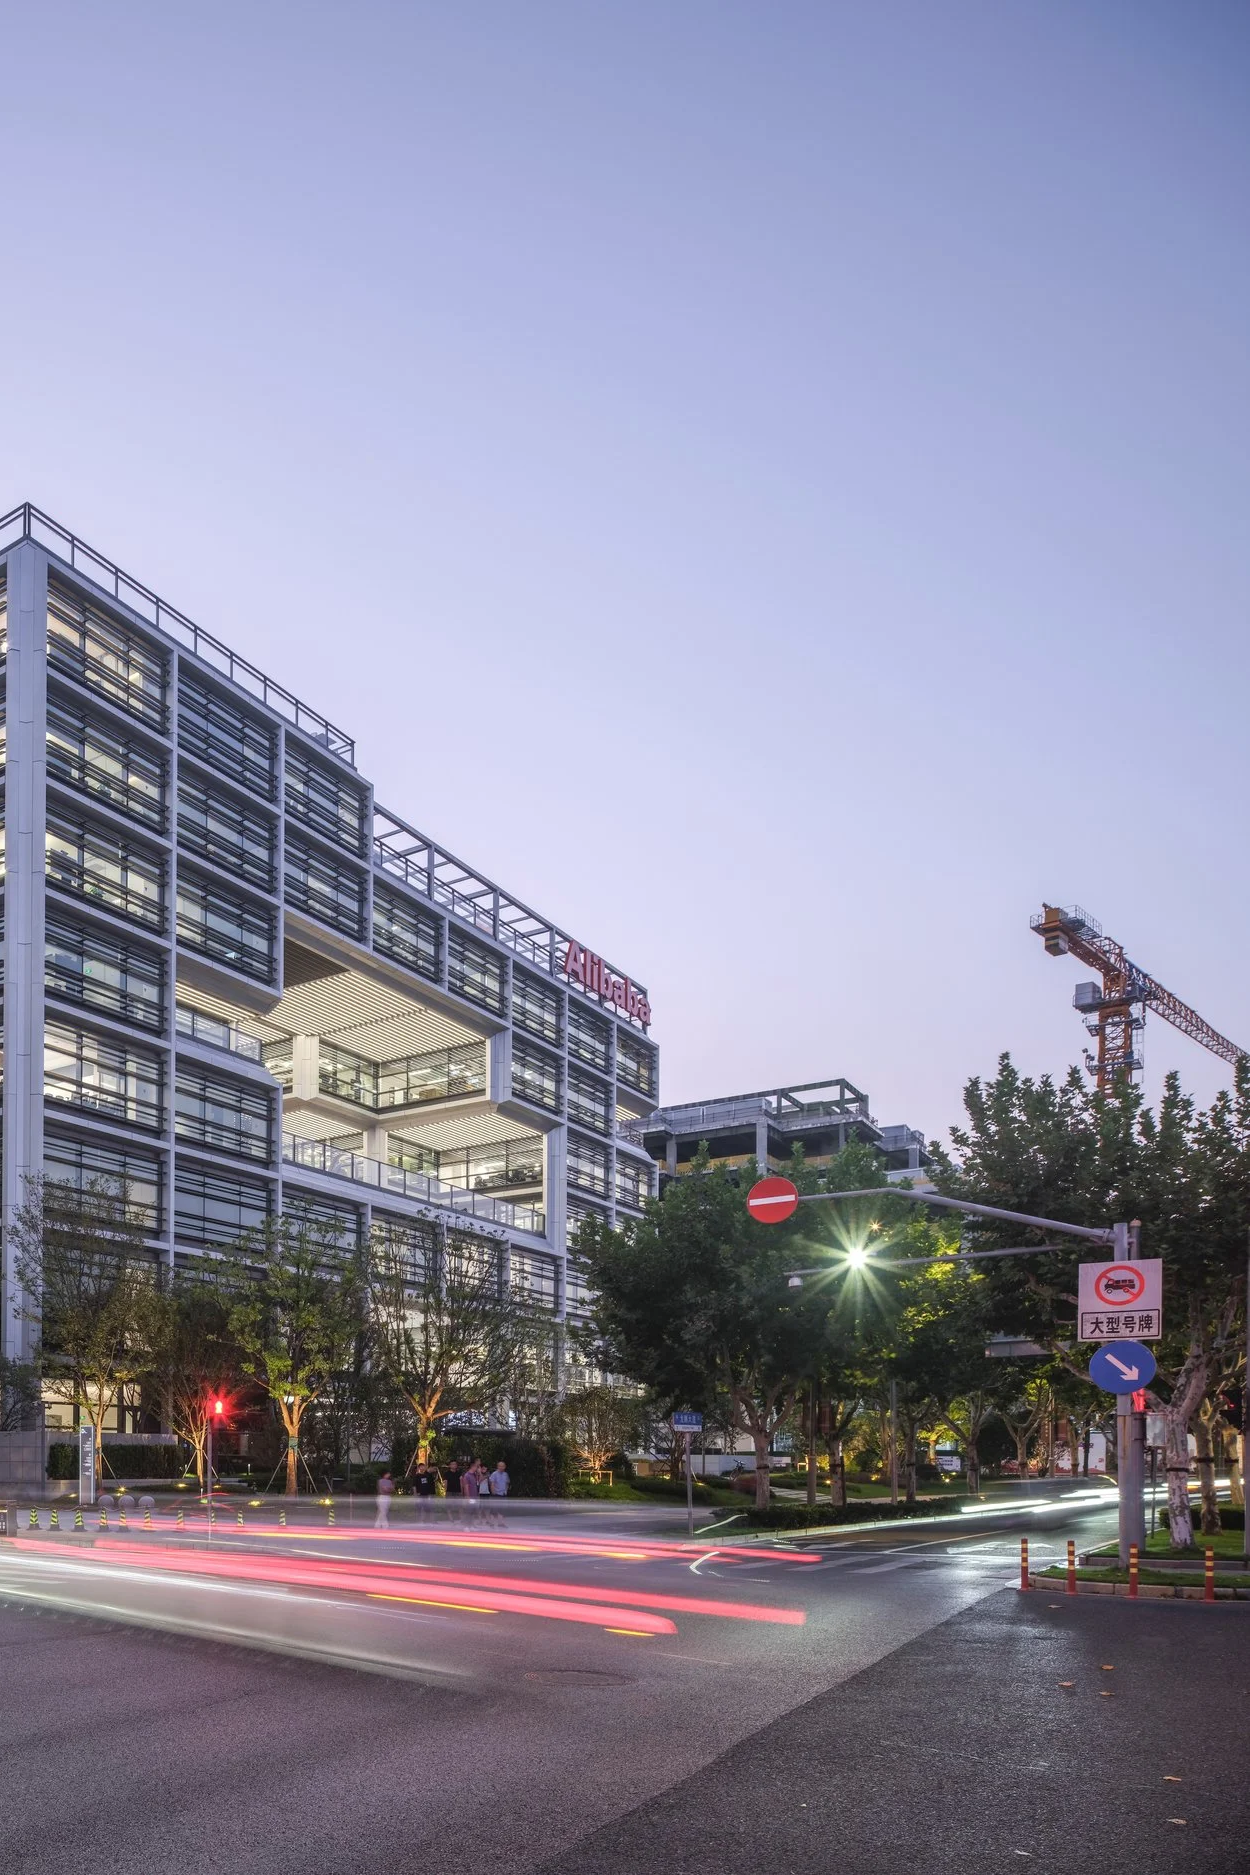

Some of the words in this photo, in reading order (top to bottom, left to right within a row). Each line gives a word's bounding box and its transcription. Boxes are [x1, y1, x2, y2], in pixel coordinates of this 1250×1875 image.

[564, 940, 651, 1026] Alibaba
[1090, 1314, 1153, 1335] 大型号牌
